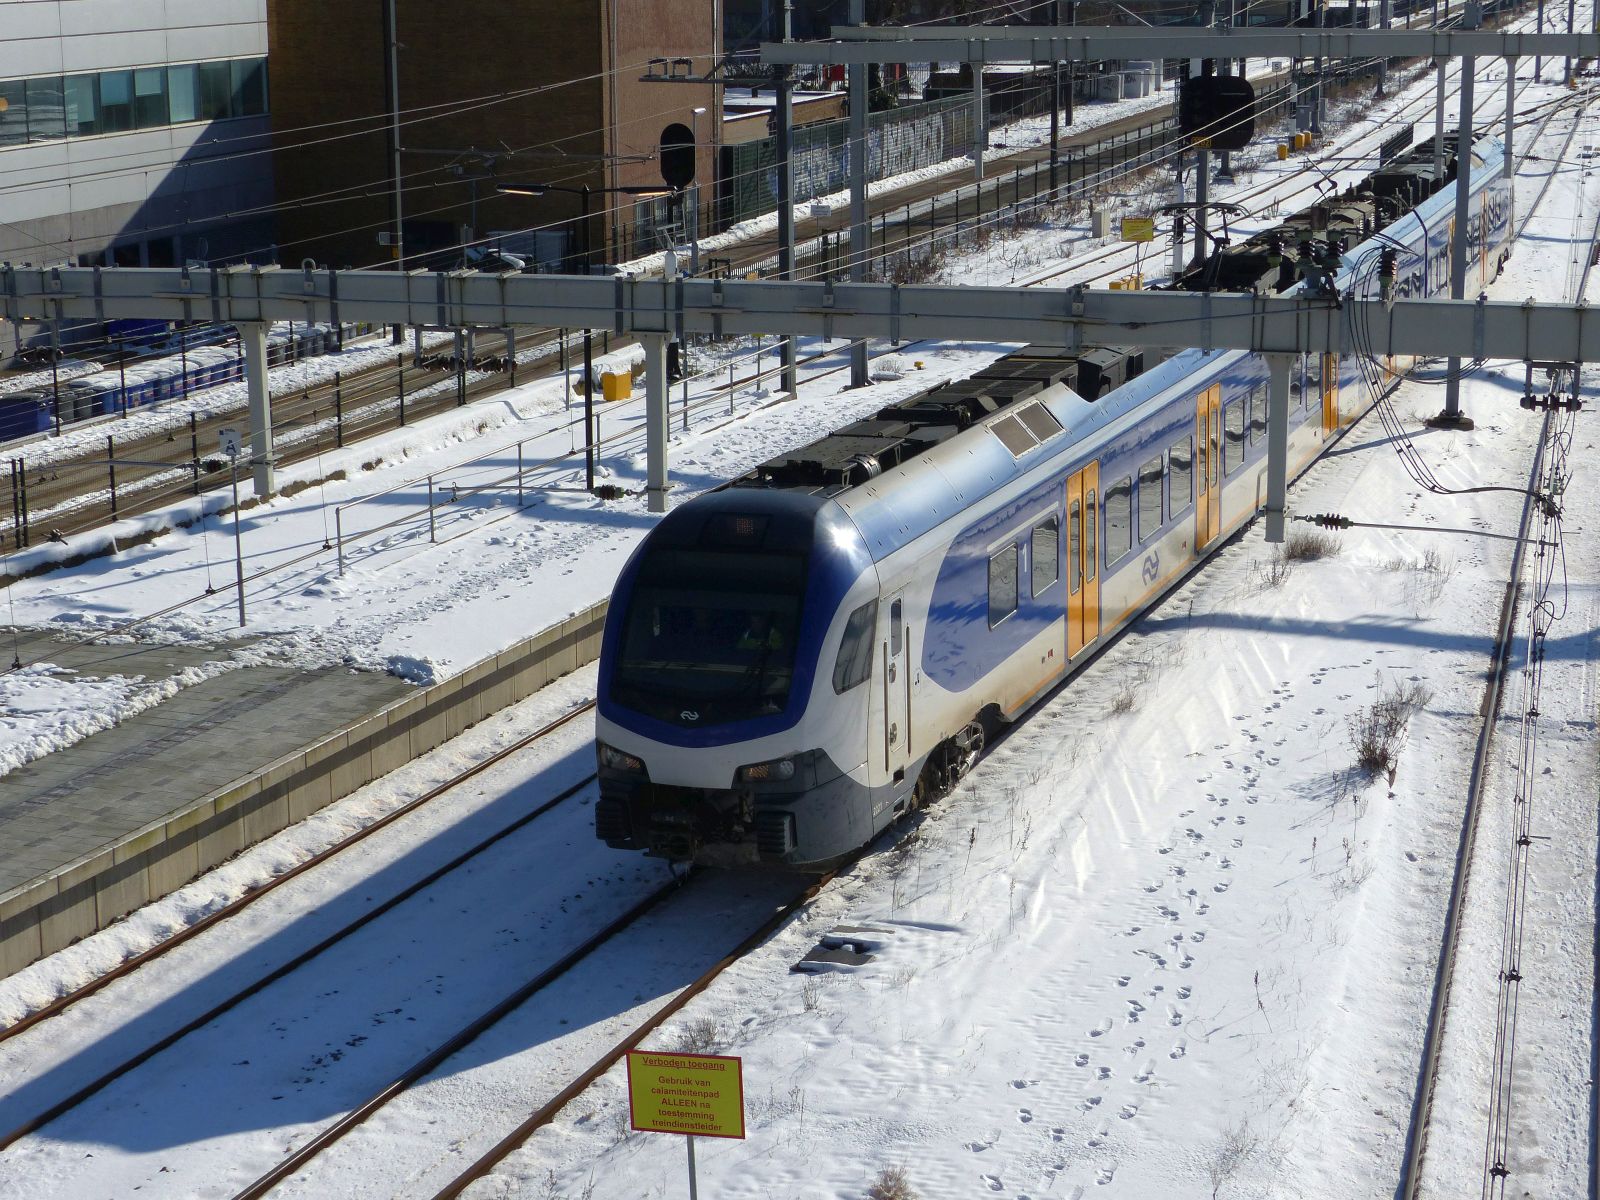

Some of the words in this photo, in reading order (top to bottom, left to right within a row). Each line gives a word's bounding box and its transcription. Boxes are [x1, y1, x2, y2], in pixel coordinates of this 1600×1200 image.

[225, 439, 237, 454] A
[1022, 543, 1028, 573] 1
[642, 1056, 686, 1068] Verboden
[688, 1060, 725, 1072] toegang
[658, 1075, 693, 1085] Gebruik
[695, 1079, 711, 1087] van
[651, 1088, 720, 1099] calamiteitenpad
[661, 1098, 697, 1108] ALLEEN
[699, 1101, 711, 1109] na
[658, 1109, 715, 1121] toestemming
[652, 1119, 722, 1132] treindienstleider
